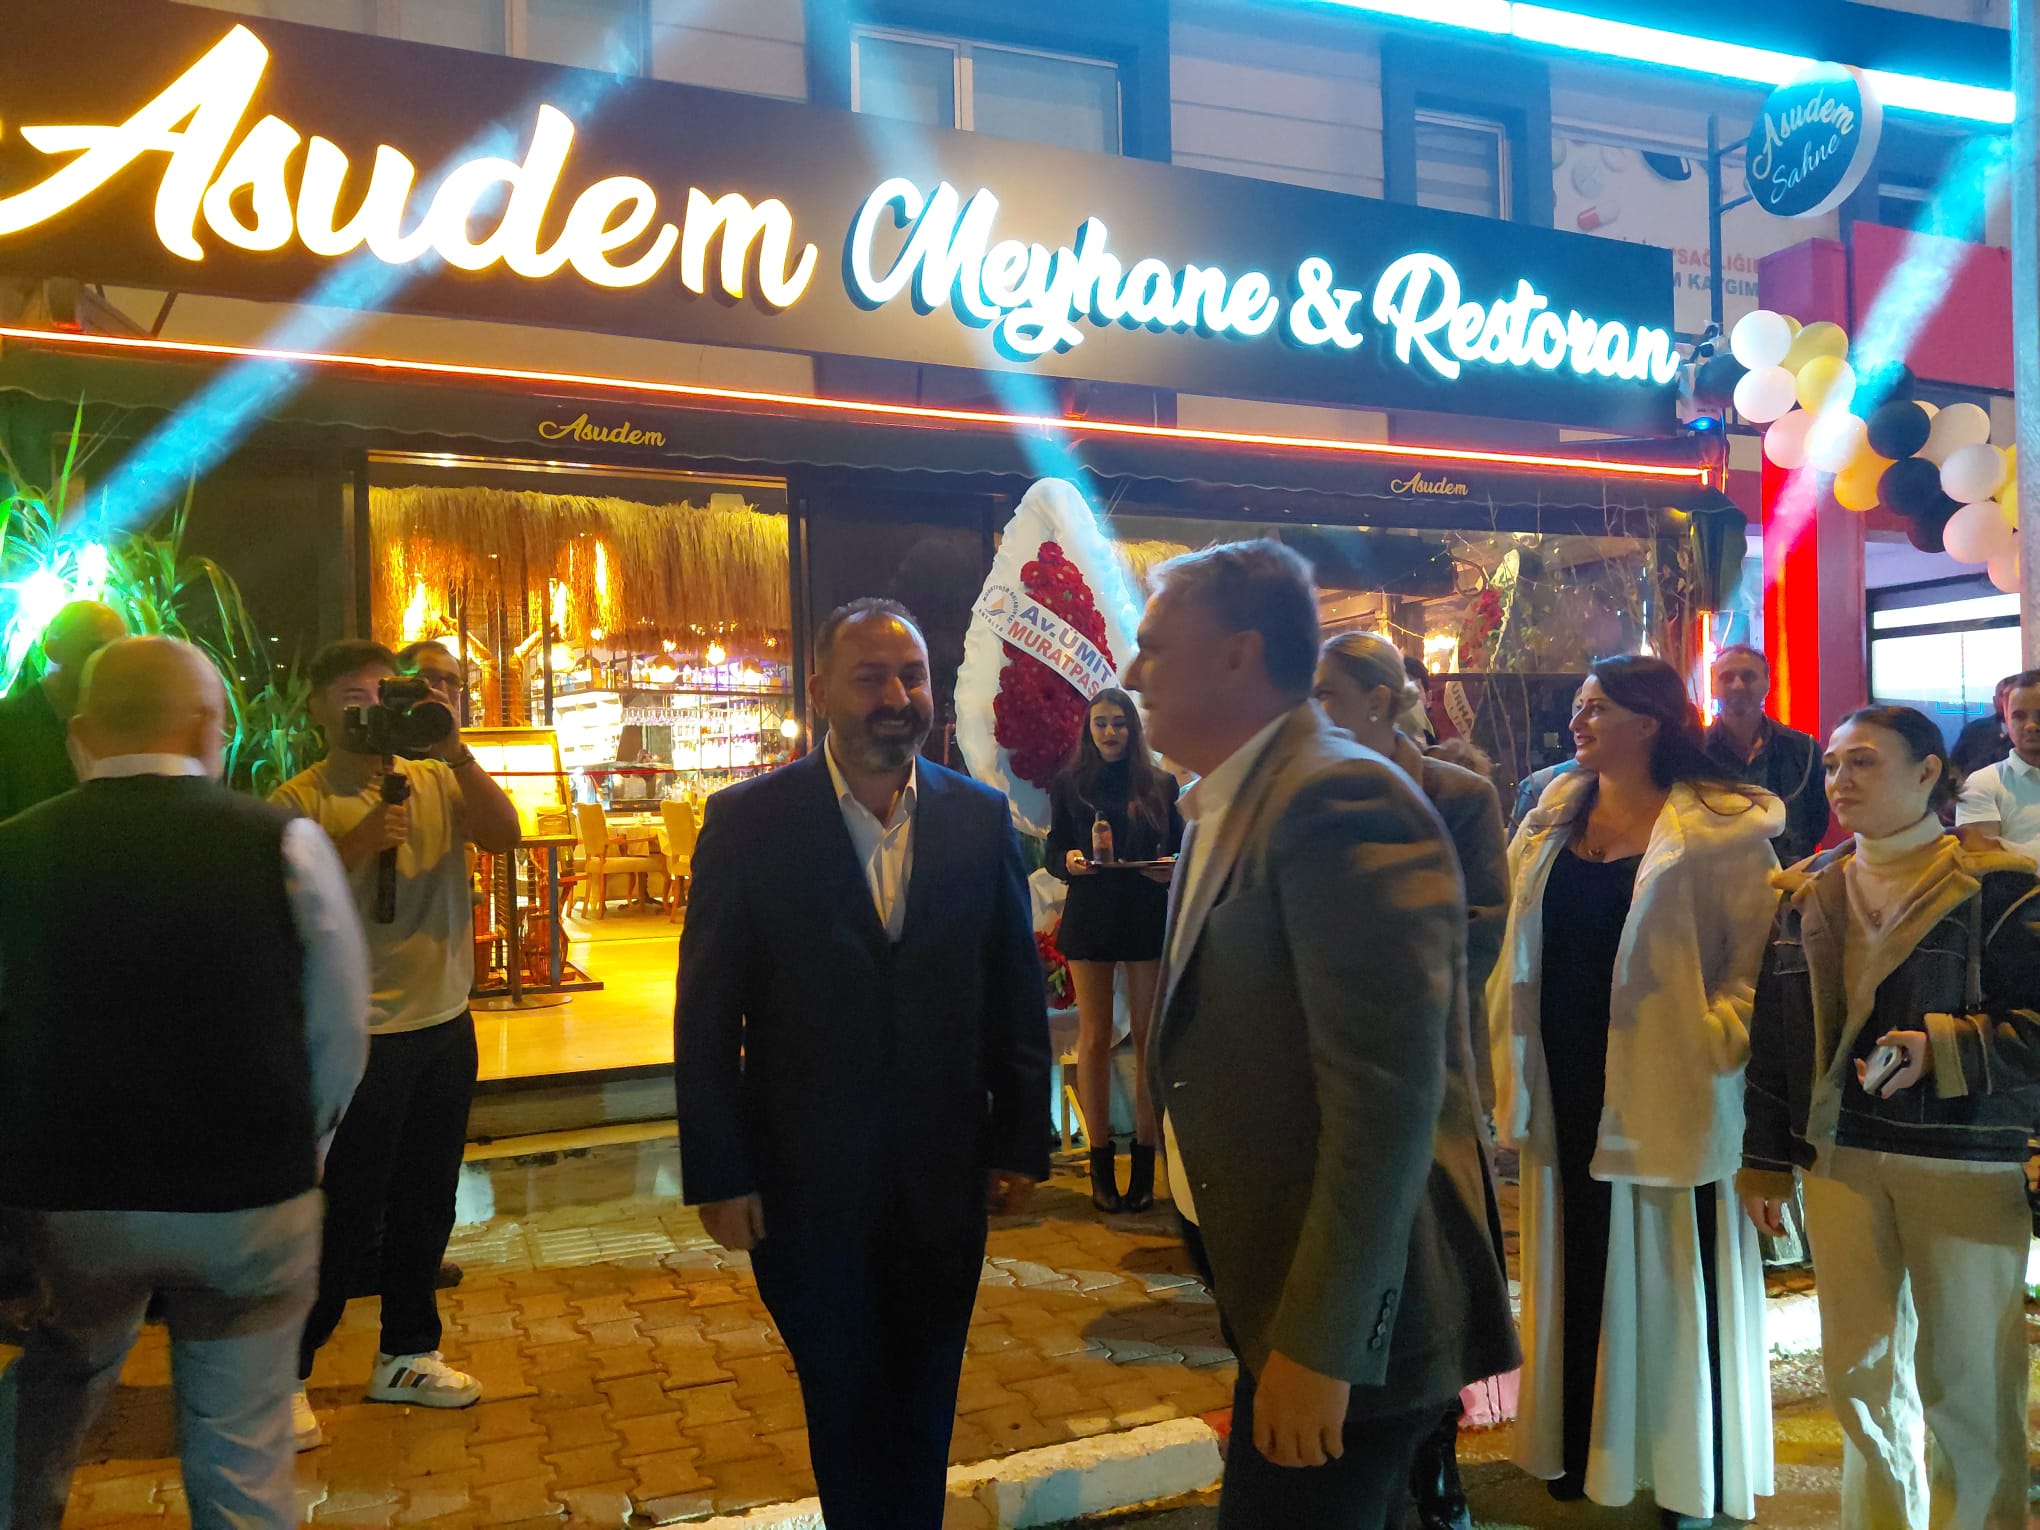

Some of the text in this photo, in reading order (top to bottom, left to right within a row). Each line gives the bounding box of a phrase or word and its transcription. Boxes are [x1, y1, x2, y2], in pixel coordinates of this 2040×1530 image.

[0, 23, 818, 309] Asudem
[1755, 89, 1854, 179] Asudem
[1771, 135, 1840, 203] Sahne
[843, 176, 1679, 382] Meyhane & Restoran
[538, 412, 666, 447] Asudem
[1390, 471, 1469, 496] Asudem
[1058, 627, 1112, 684] ÜMİT
